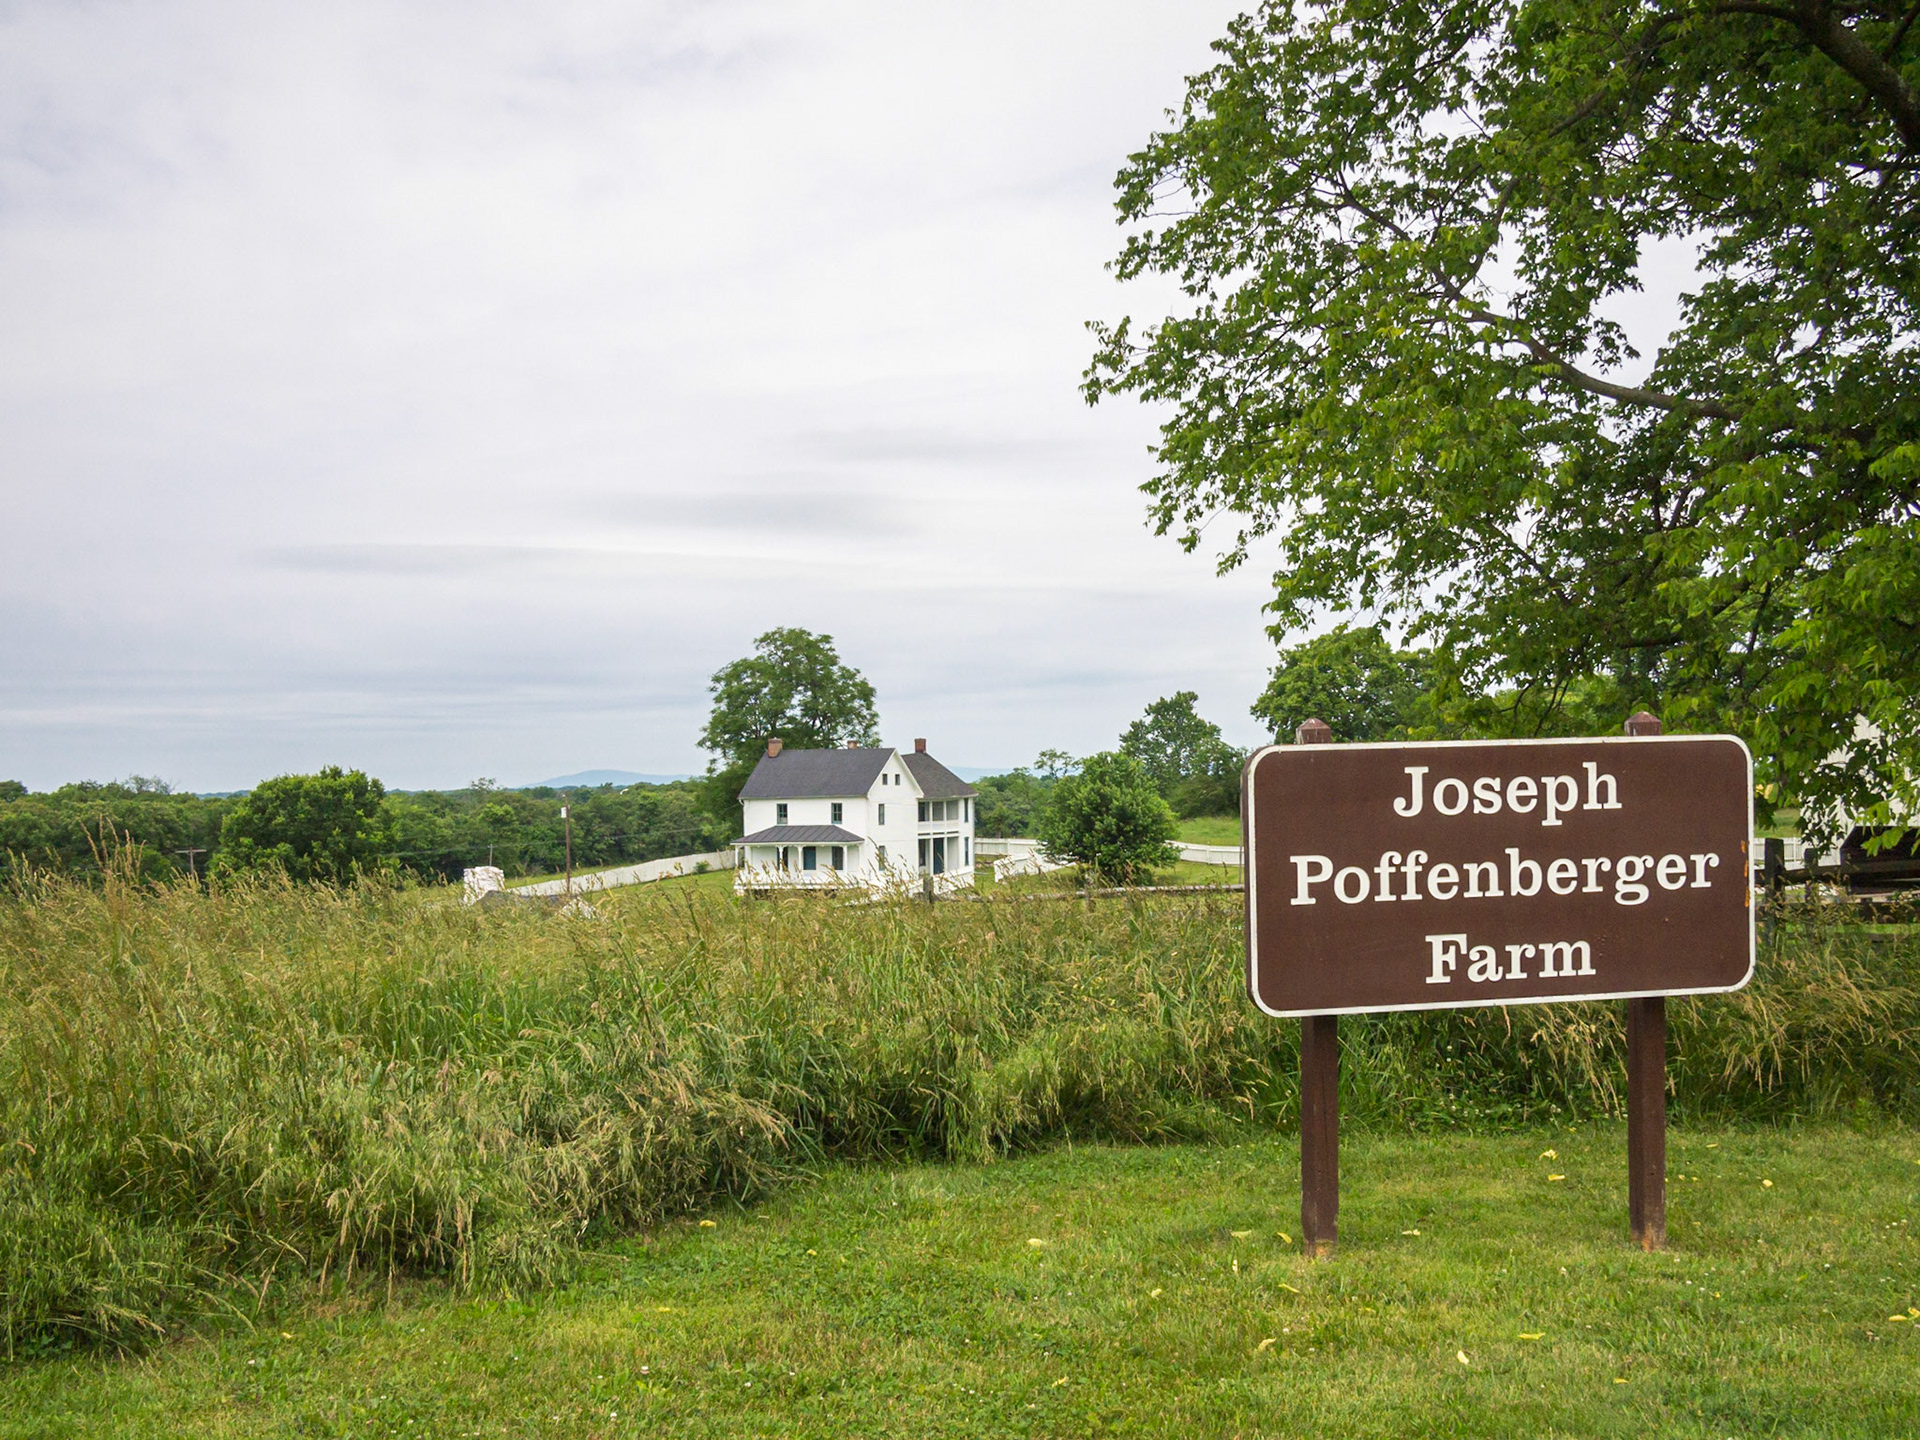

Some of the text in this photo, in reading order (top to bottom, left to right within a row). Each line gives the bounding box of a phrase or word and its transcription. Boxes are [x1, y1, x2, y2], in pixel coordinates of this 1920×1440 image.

[1393, 762, 1622, 827] Joseph
[1289, 847, 1720, 906] Poffenberger
[1424, 933, 1597, 984] Farm
